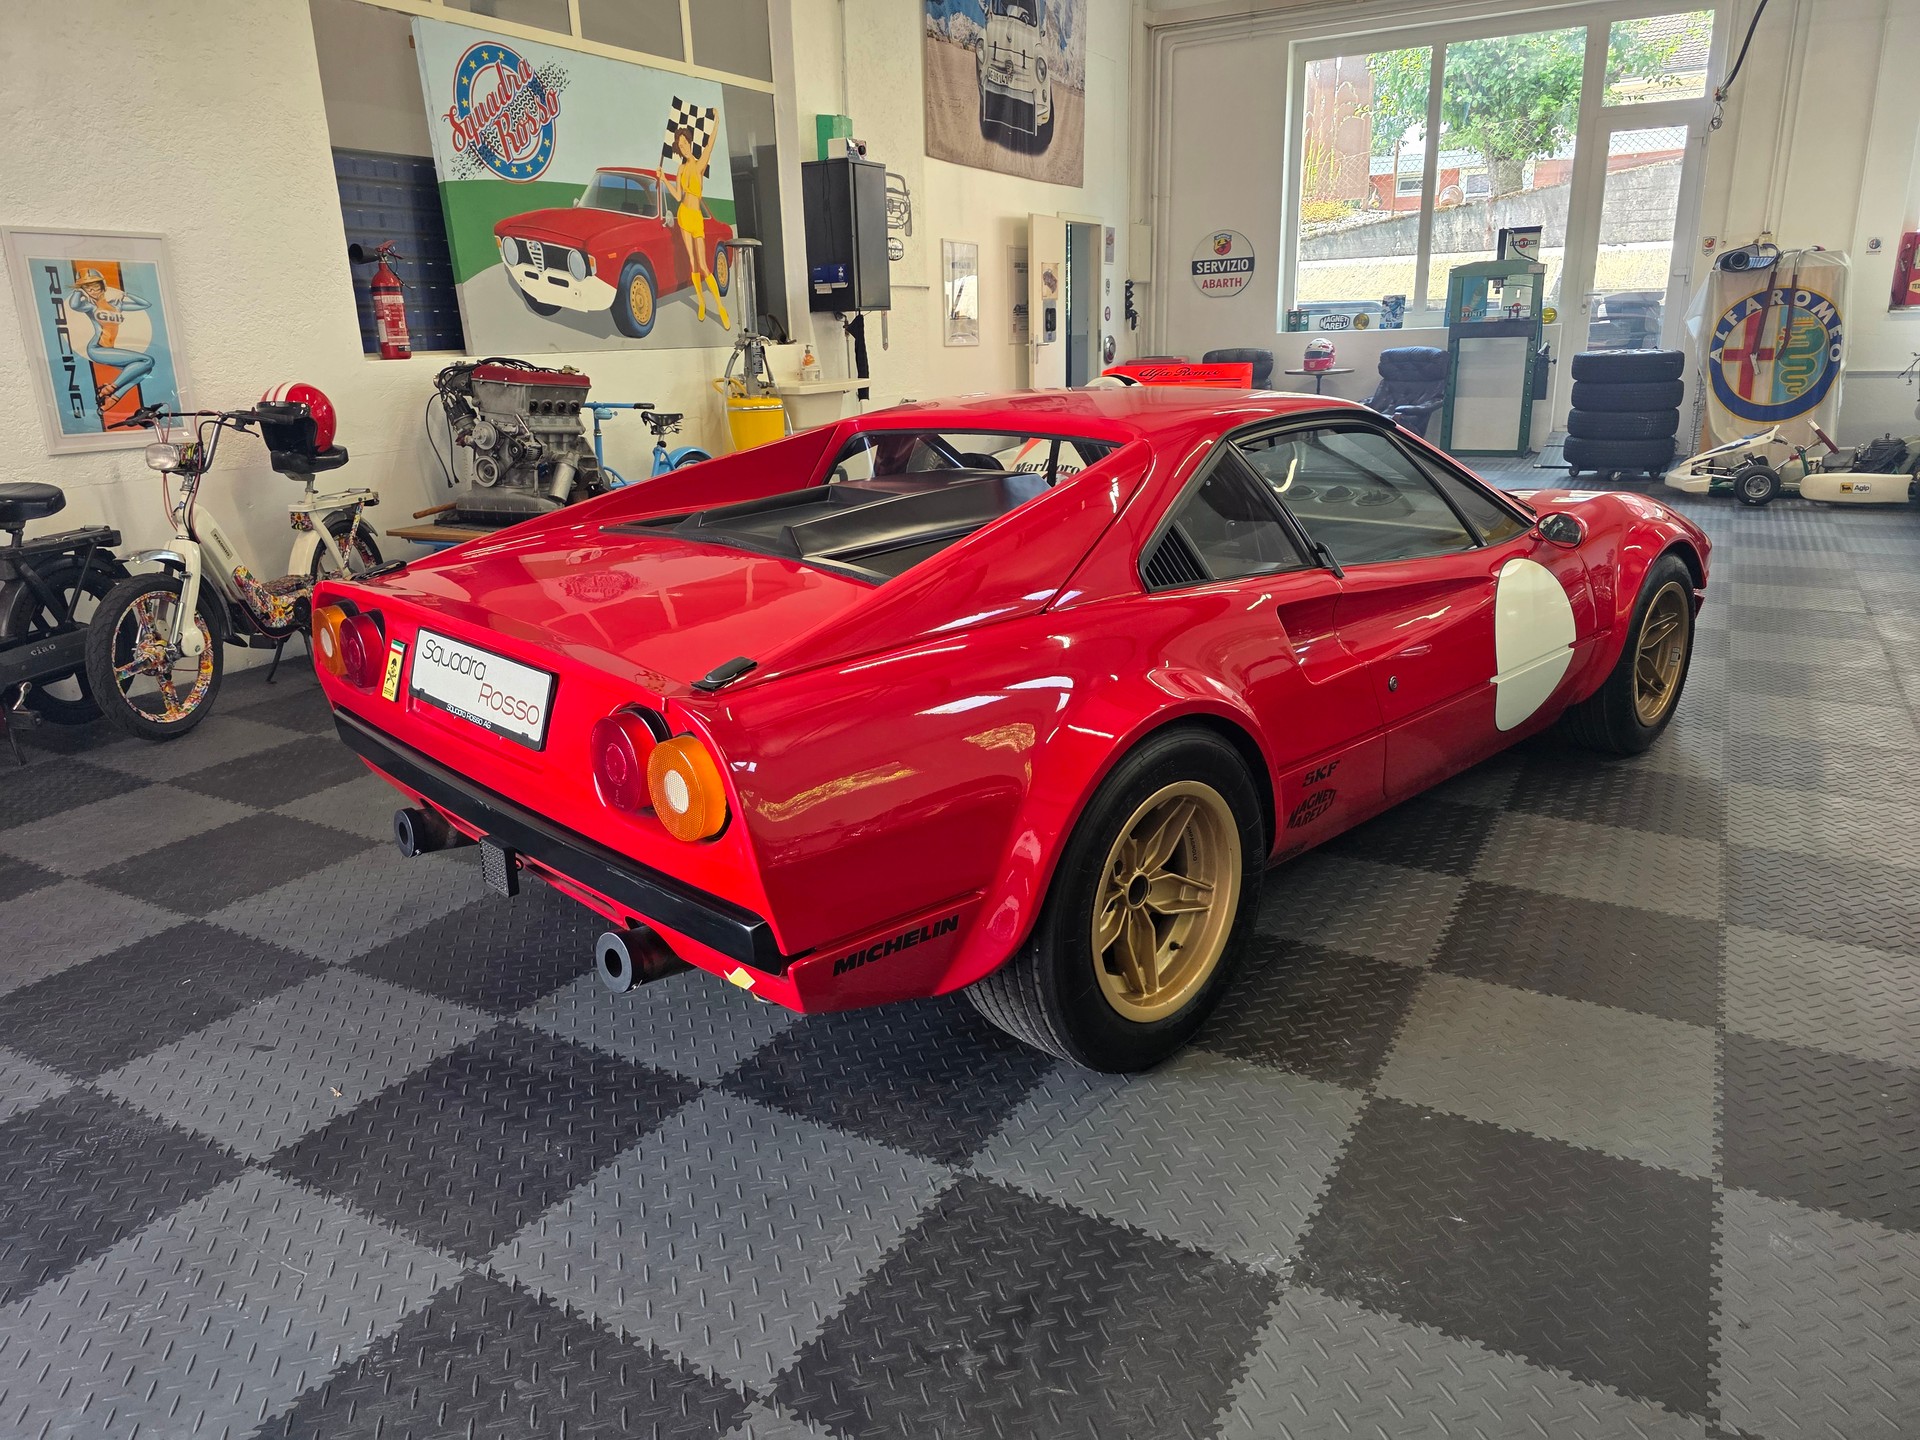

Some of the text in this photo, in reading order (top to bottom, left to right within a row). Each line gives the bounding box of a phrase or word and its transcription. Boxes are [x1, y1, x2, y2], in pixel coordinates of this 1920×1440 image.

[442, 59, 533, 153] Squadra
[493, 87, 559, 163] Rosso
[1196, 259, 1249, 274] SERVIZIO
[1202, 277, 1242, 289] ABARTH
[96, 311, 125, 323] Gulf
[1711, 289, 1844, 365] ALFA ROMEO
[44, 265, 86, 419] RACING
[1139, 367, 1220, 380] Alfa Romeo
[1014, 458, 1080, 474] Marloro
[1853, 484, 1870, 492] Agip
[30, 643, 56, 656] ciao
[422, 639, 487, 681] Squadra
[1302, 760, 1341, 788] SKF
[832, 914, 960, 977] MICHELIN
